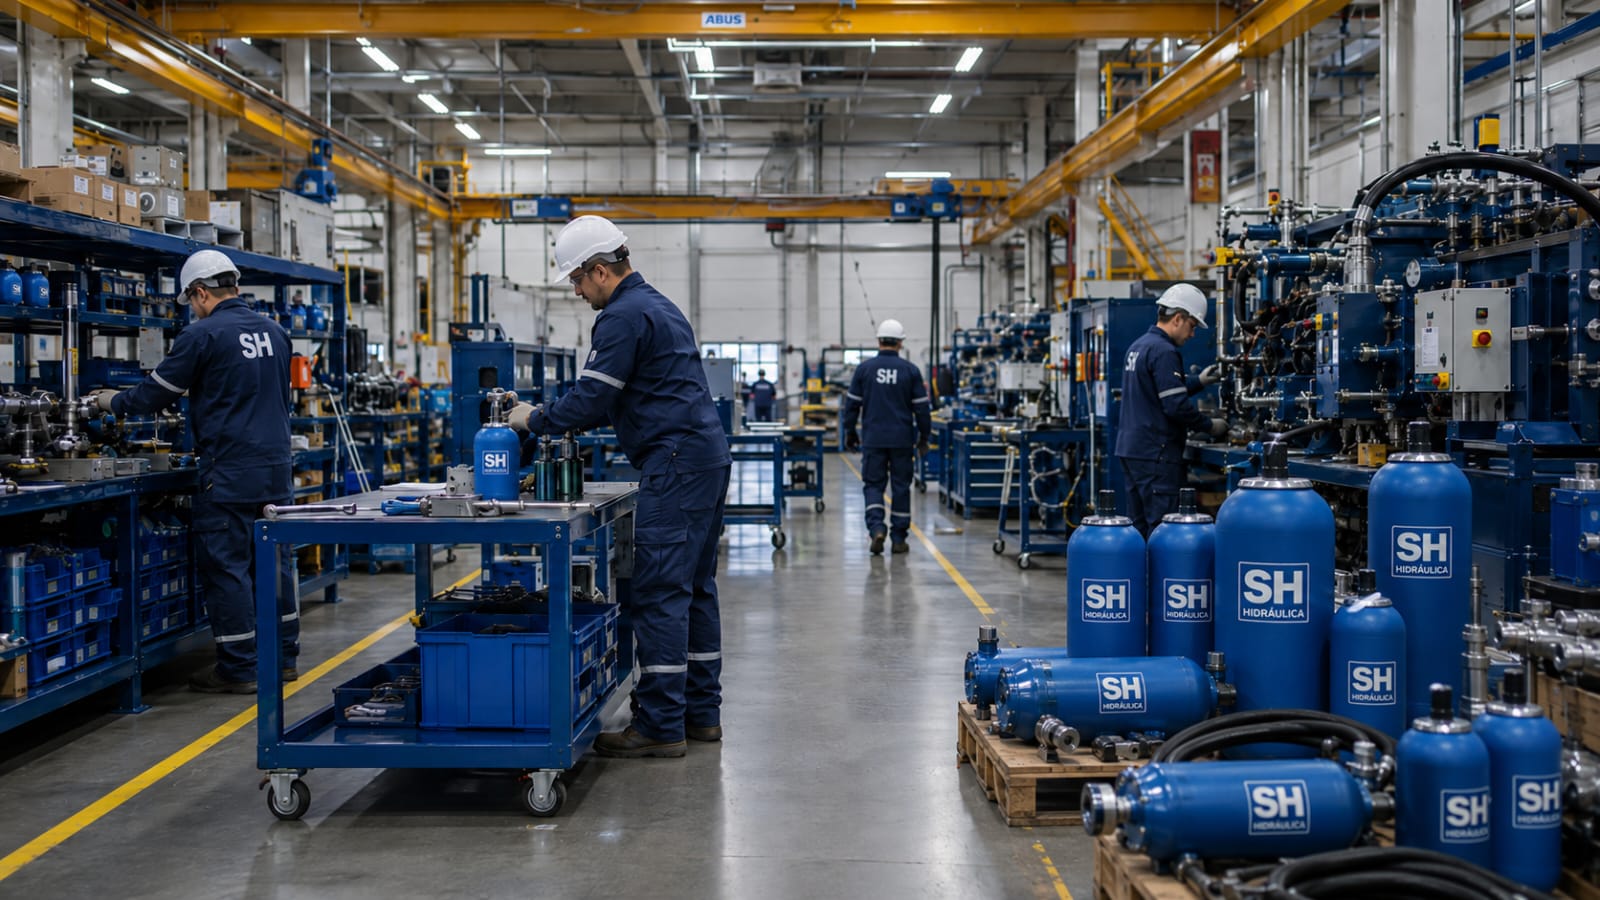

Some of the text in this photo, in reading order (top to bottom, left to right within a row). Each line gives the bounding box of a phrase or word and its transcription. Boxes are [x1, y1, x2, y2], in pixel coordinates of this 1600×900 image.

[705, 14, 742, 25] ABUS
[239, 331, 274, 359] SH
[876, 368, 898, 385] SH
[484, 453, 507, 468] SH
[1396, 531, 1447, 562] SH
[1395, 563, 1449, 575] HIDRÁULICA
[1086, 583, 1126, 610] SH
[1167, 583, 1208, 610] SH
[1243, 568, 1304, 605] SH
[1084, 610, 1127, 620] HIDRÁULICA
[1166, 610, 1209, 620] HIDRÁULICA
[1242, 607, 1305, 619] HIDRÁULICA
[1101, 676, 1142, 701] SH
[1352, 666, 1393, 692] SH
[1351, 692, 1394, 702] HIDRÁULICA
[1252, 785, 1306, 819] SH
[1518, 780, 1560, 813] SH
[1446, 794, 1489, 827] SH
